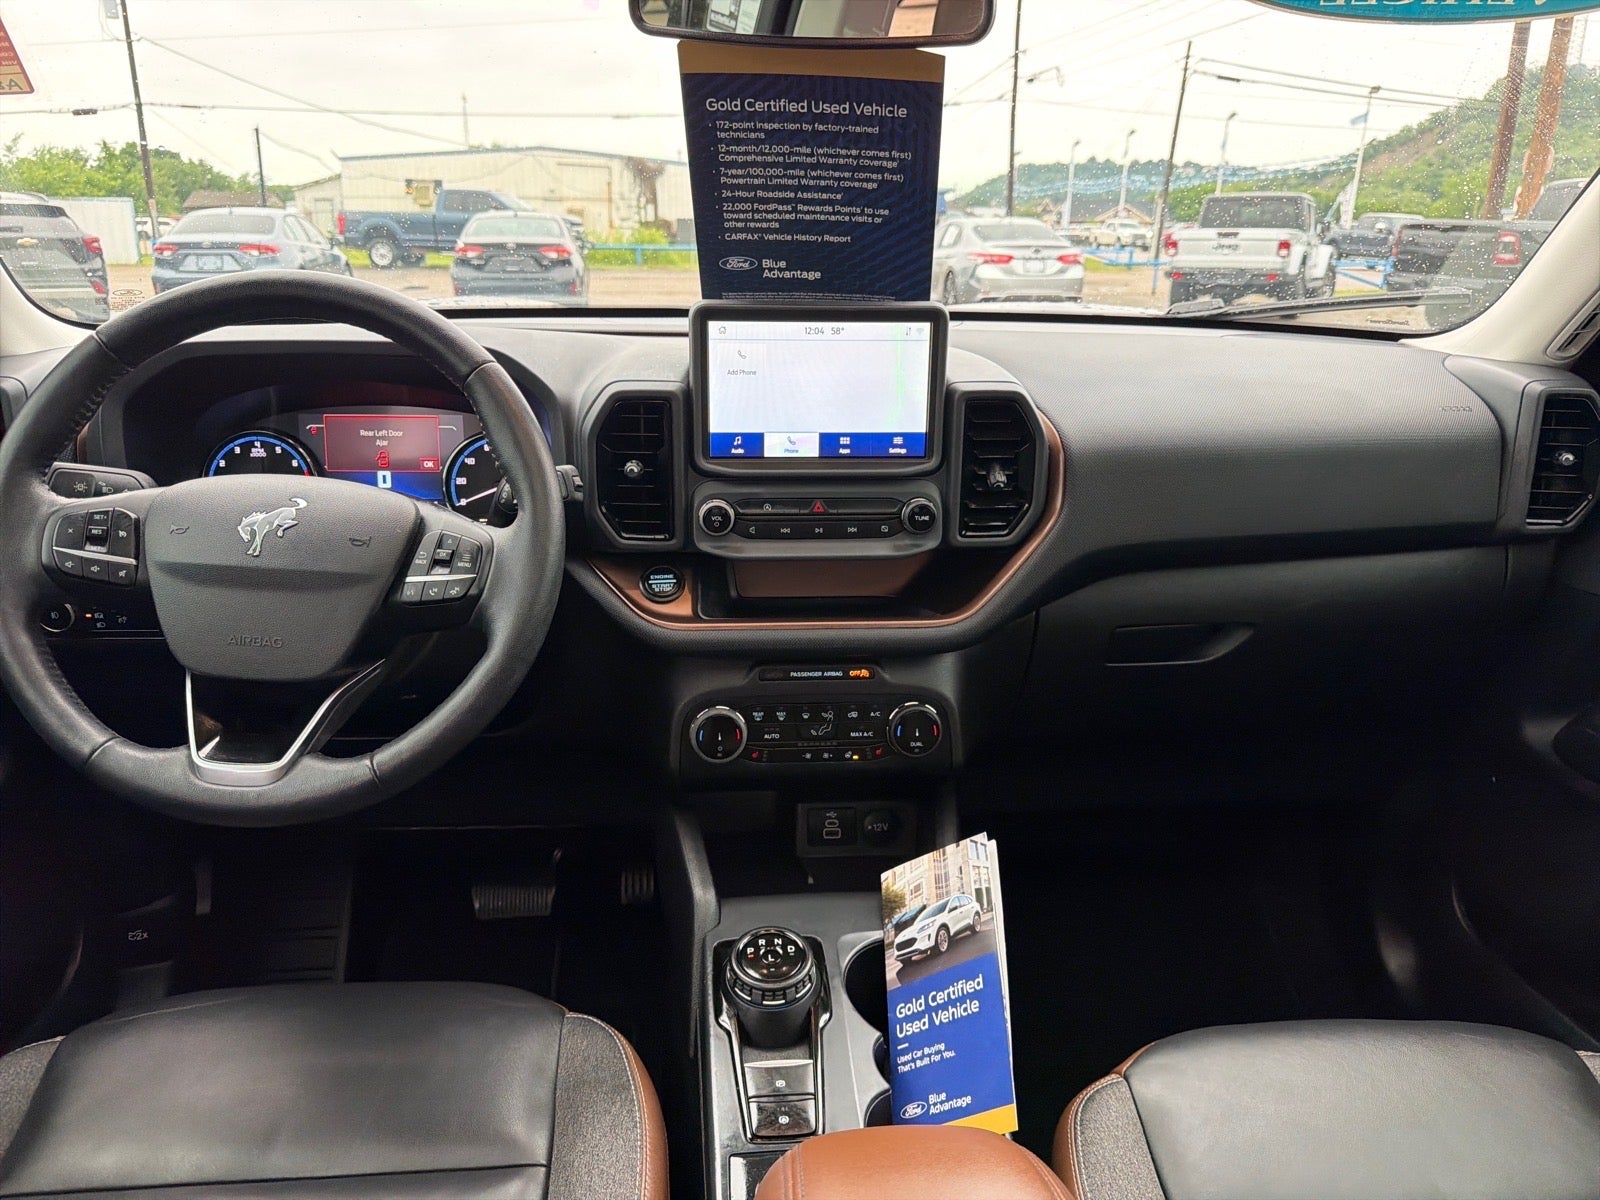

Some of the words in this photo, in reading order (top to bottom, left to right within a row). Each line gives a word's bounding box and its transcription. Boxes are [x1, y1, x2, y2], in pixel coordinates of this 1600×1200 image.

[705, 98, 741, 111] Gold
[744, 98, 808, 113] Certified
[811, 100, 850, 115] Used
[853, 102, 908, 118] Vehicle
[715, 121, 754, 131] 172-point
[756, 122, 801, 131] inspection
[802, 122, 814, 132] by
[815, 123, 880, 134] factory-trained
[717, 131, 766, 139] technicians
[718, 144, 812, 154] 12-month/12,000-mile
[813, 147, 860, 156] (whichever
[891, 150, 912, 161] first)
[718, 154, 784, 163] Comprehensive
[785, 155, 817, 164] Limited
[819, 156, 858, 166] Warranty
[719, 167, 806, 177] 7-year/100,000-mile
[807, 169, 853, 178] (whichever
[854, 172, 882, 180] comes
[883, 172, 904, 183] first)
[720, 176, 766, 185] Powertrain
[767, 177, 799, 185] Limited
[800, 178, 839, 187] Warranty
[721, 189, 755, 198] 24-Hour
[756, 190, 795, 199] Roadside
[722, 203, 752, 212] 22,000
[797, 204, 833, 213] Rewards
[864, 206, 874, 214] to
[874, 208, 890, 216] use
[723, 211, 753, 219] toward
[753, 211, 796, 220] scheduled
[796, 212, 850, 222] maintenance
[851, 215, 873, 223] visits
[723, 220, 746, 228] other
[747, 220, 780, 229] rewards
[763, 233, 792, 242] Vehicle
[793, 233, 823, 243] History
[823, 234, 852, 244] Report
[762, 259, 787, 269] Blue
[763, 269, 822, 280] Advantage
[804, 326, 825, 335] 12:04
[727, 368, 739, 376] Add
[739, 368, 757, 376] Phone
[360, 429, 375, 437] Rear
[375, 429, 388, 437] Left
[388, 429, 404, 437] Door
[376, 439, 389, 447] Ajar
[888, 447, 908, 455] Settings
[423, 460, 435, 468] OK
[229, 634, 283, 648] AIRBAG
[849, 669, 861, 677] OFF
[787, 945, 795, 953] D
[896, 995, 925, 1018] Gold
[928, 973, 984, 1007] Certified
[896, 1014, 929, 1038] Used
[932, 999, 980, 1026] Vehicle
[897, 1052, 912, 1064] Used
[912, 1049, 923, 1059] Car
[923, 1043, 945, 1055] Buying
[898, 1062, 915, 1074] That's
[916, 1056, 930, 1068] Built
[930, 1053, 941, 1063] For
[928, 1092, 947, 1105] Blue
[929, 1095, 972, 1116] Advantage
